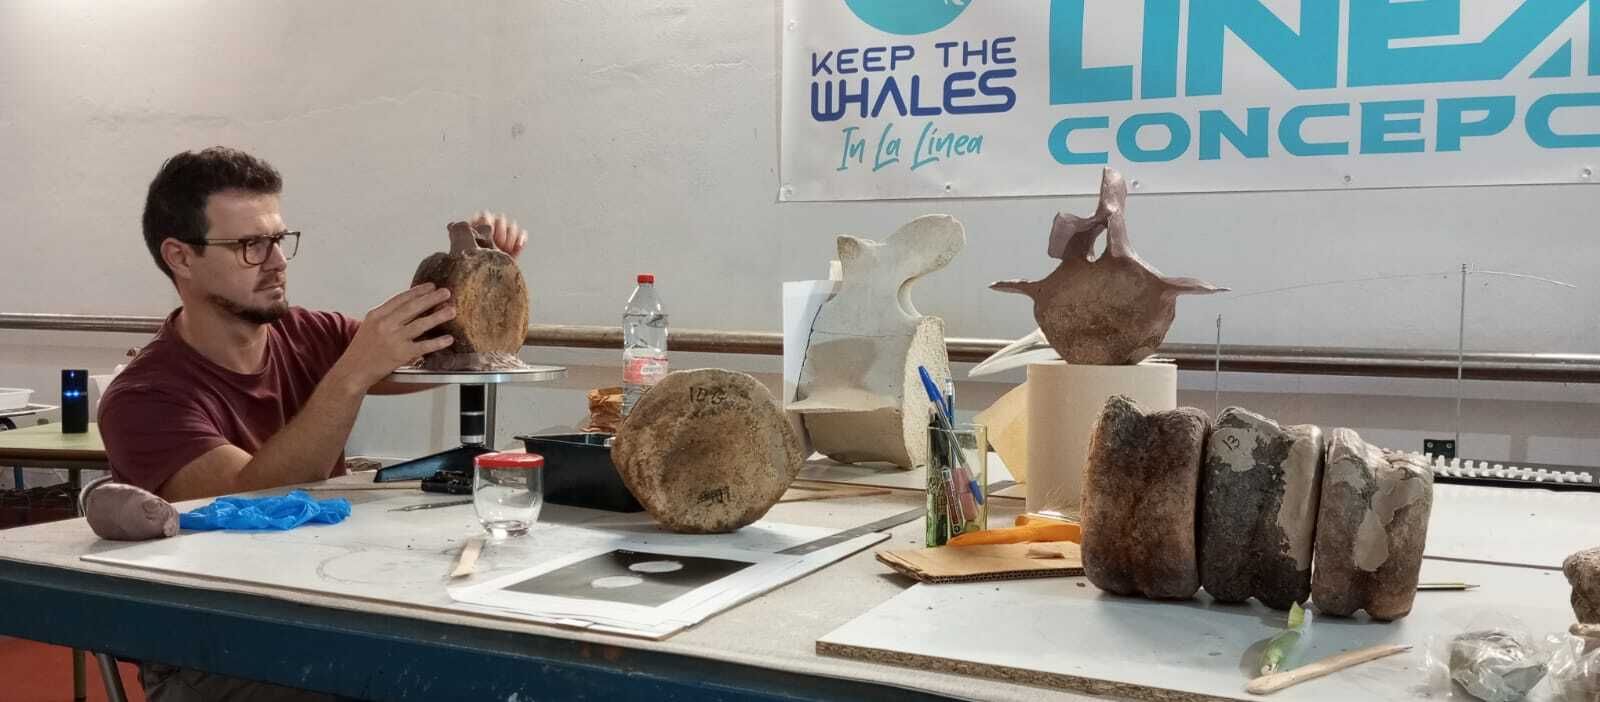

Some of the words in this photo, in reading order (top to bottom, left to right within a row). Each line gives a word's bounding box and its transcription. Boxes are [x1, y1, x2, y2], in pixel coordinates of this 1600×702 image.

[811, 45, 915, 77] KEEP
[934, 36, 1017, 68] THE
[811, 68, 1017, 122] WHALES
[836, 126, 866, 172] In
[872, 122, 901, 172] La
[1222, 435, 1240, 451] 13
